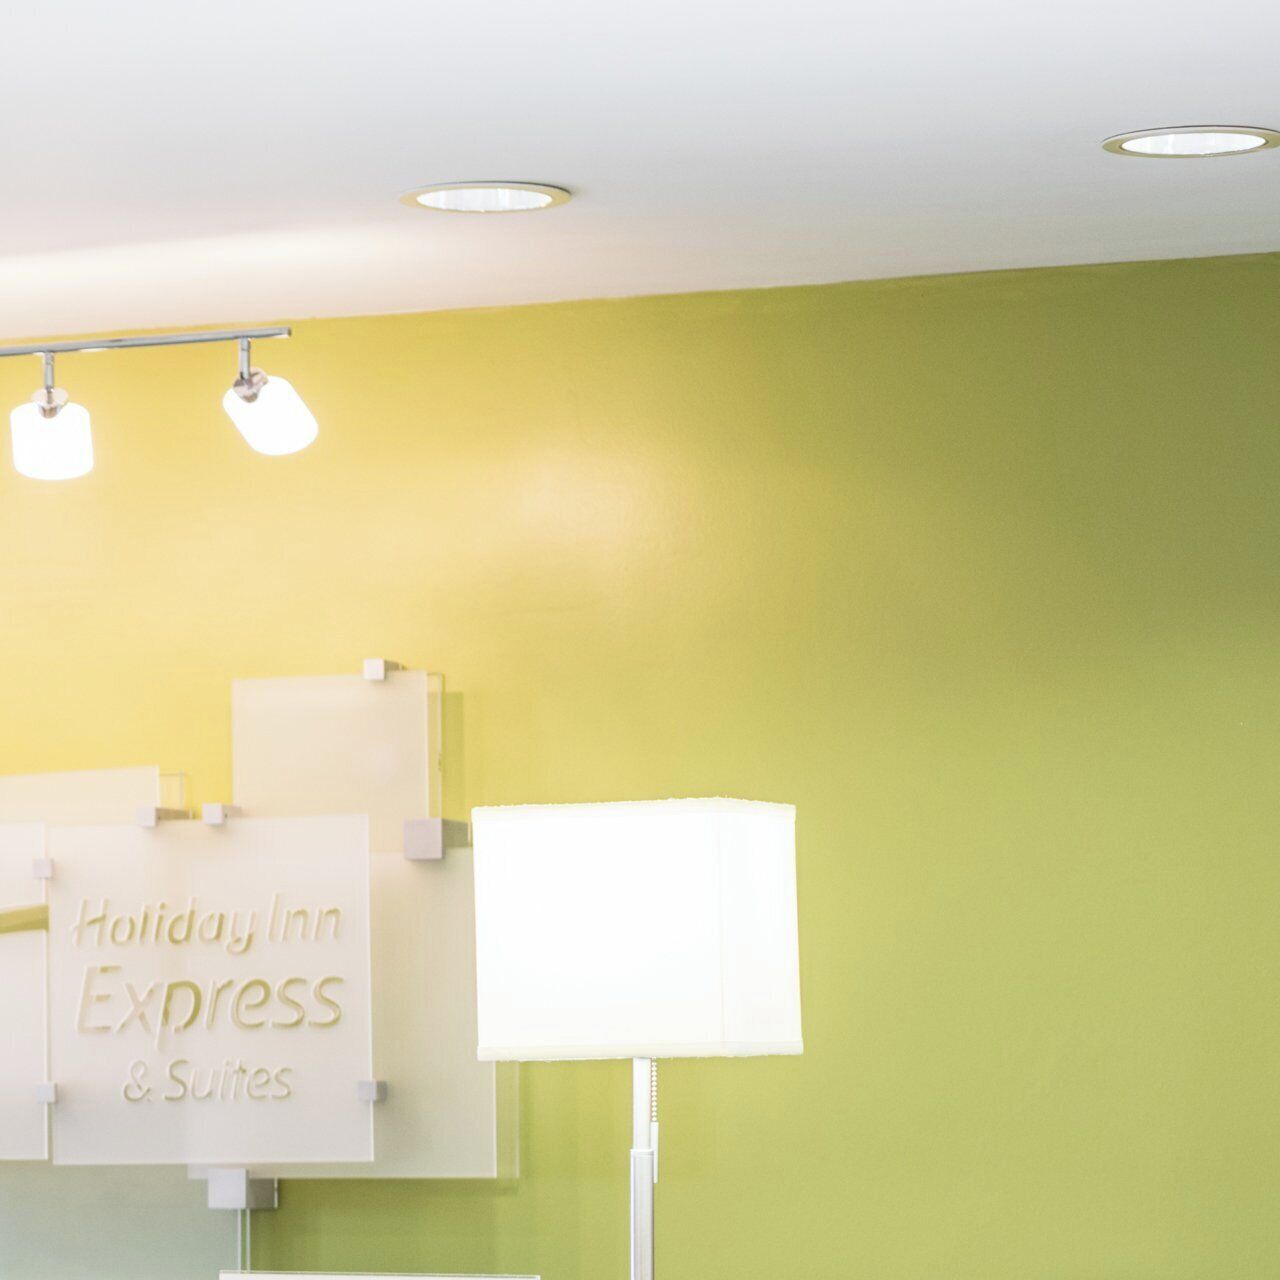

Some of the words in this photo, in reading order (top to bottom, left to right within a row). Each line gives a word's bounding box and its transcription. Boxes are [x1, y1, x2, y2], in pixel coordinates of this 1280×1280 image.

[71, 896, 257, 956] Holiday
[267, 892, 344, 943] Inn
[75, 963, 345, 1052] Express
[122, 1059, 152, 1103] &
[163, 1057, 294, 1103] Suites
